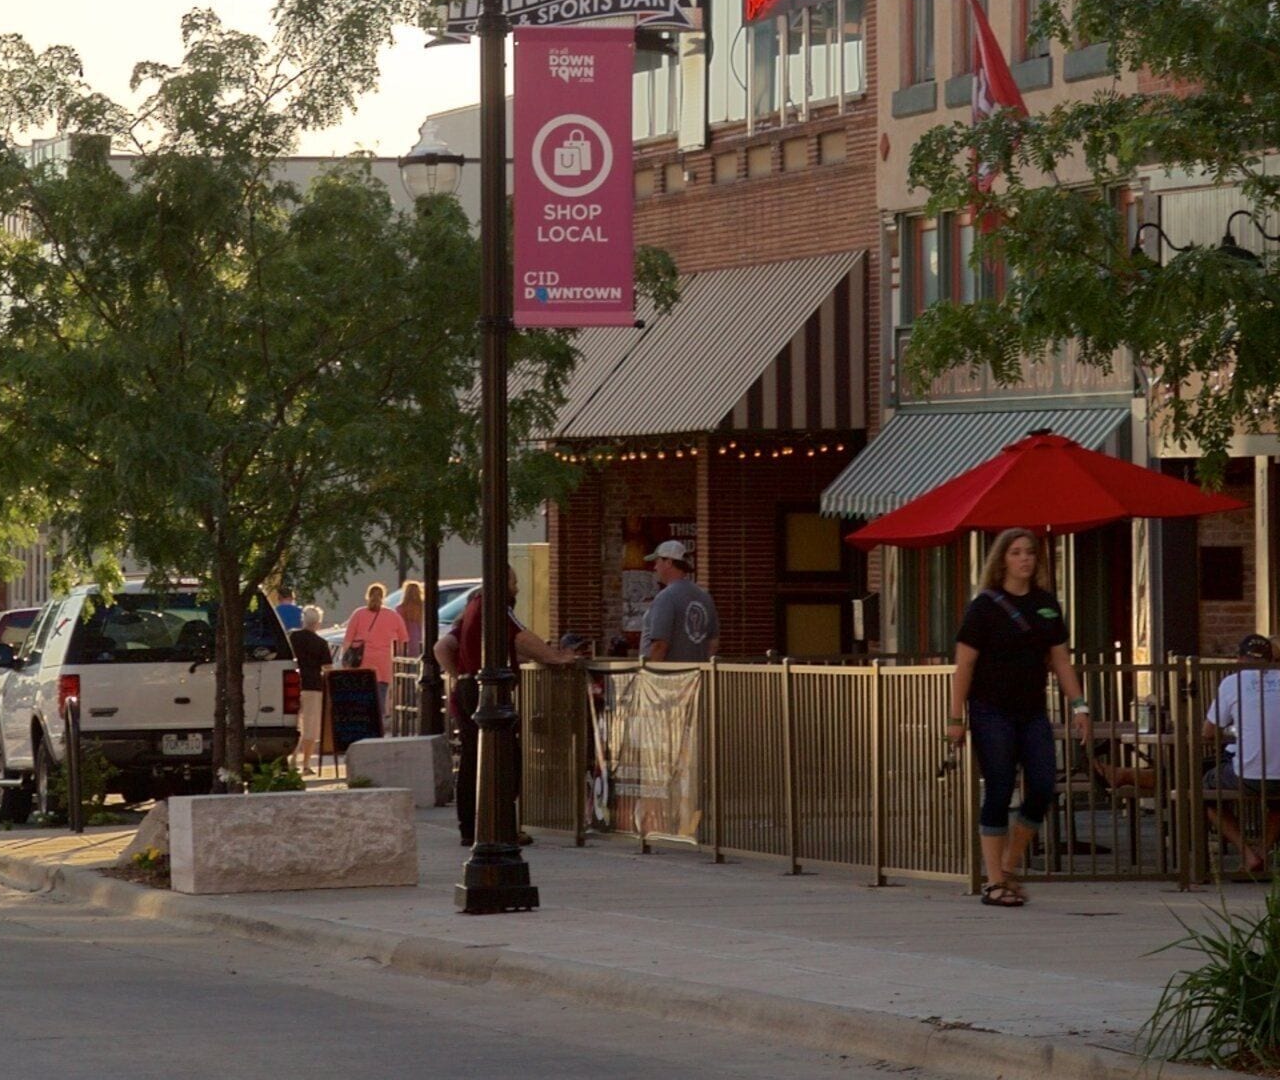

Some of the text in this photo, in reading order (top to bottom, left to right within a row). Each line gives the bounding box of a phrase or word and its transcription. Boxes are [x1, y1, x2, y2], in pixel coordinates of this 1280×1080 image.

[549, 55, 594, 66] DOWN
[549, 66, 594, 83] TOWN
[544, 204, 602, 220] SHOP
[538, 226, 608, 242] LOCAL
[524, 271, 560, 286] CID
[669, 522, 697, 537] THIS
